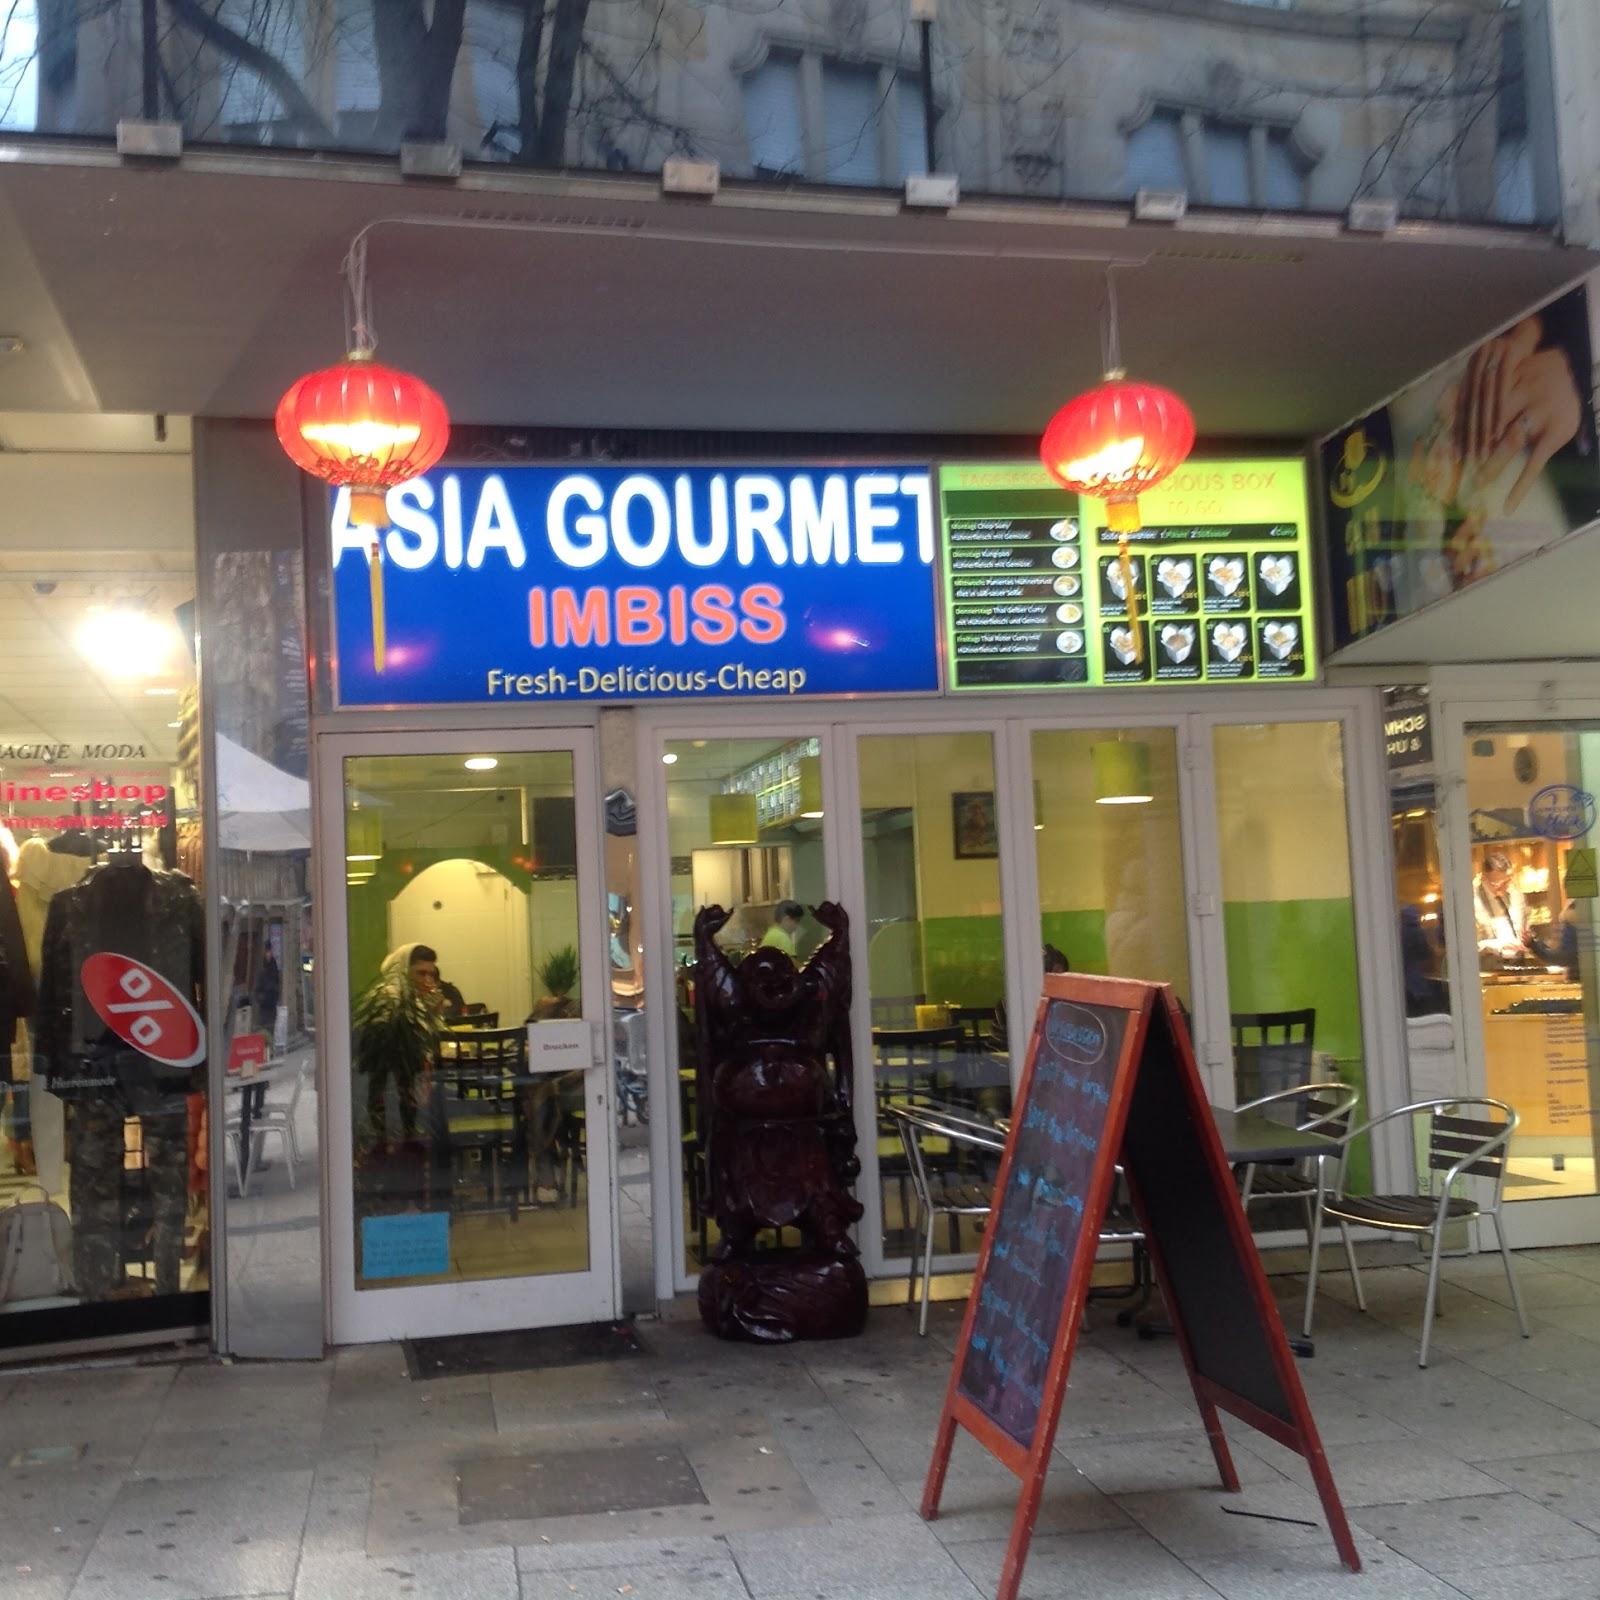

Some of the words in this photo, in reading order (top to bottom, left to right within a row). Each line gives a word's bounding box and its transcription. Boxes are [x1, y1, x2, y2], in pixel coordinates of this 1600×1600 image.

[1231, 472, 1278, 491] BOX
[331, 474, 527, 569] ASIA
[546, 473, 935, 568] GOURMET
[528, 583, 787, 647] IMBISS
[486, 661, 807, 695] Fresh-Delicious-Cheap
[80, 743, 147, 760] MODA
